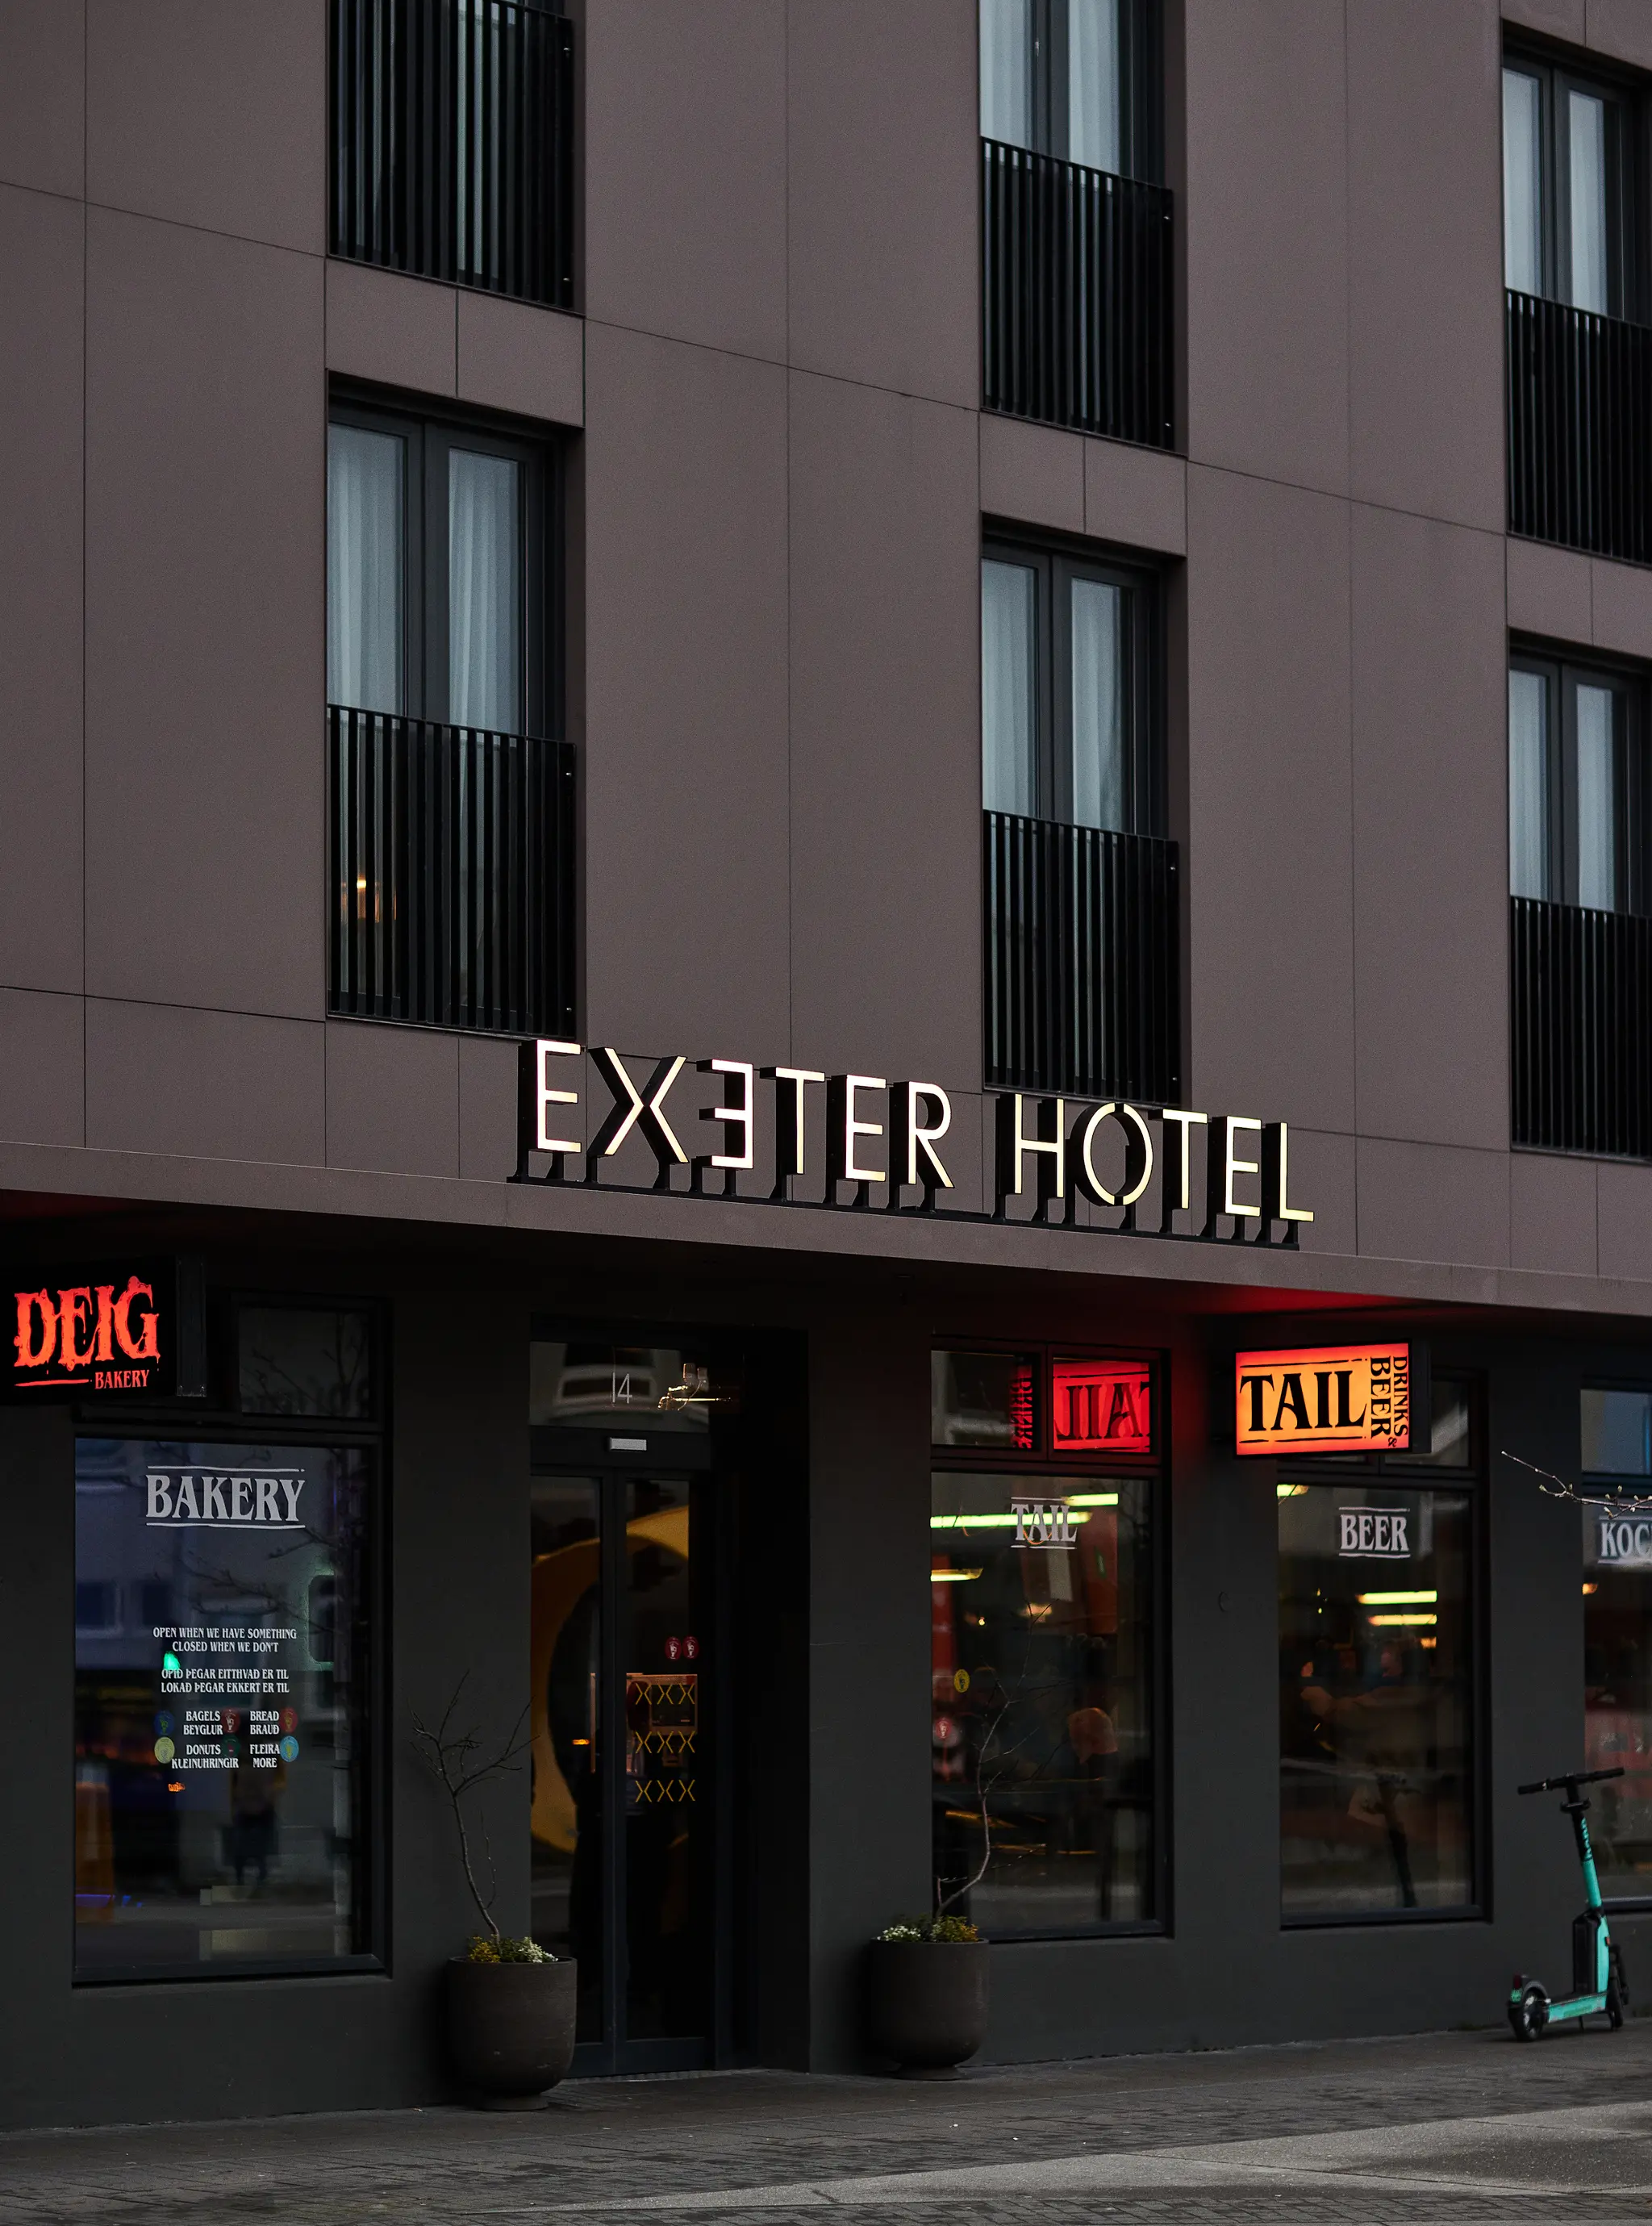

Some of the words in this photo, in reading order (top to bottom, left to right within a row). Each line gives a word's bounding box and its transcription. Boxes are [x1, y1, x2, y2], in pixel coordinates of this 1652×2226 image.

[1014, 1092, 1316, 1223] HOTEL
[13, 1275, 161, 1371] DEIG
[94, 1369, 151, 1389] BAKERY
[611, 1372, 633, 1404] 14
[1393, 1355, 1408, 1437] DRINKS
[1239, 1370, 1367, 1432] TAIL
[1370, 1355, 1391, 1439] BEER
[145, 1474, 306, 1522] BAKERY
[1010, 1503, 1078, 1543] TAIL
[1340, 1514, 1410, 1552] BEER
[1600, 1522, 1652, 1558] KOC
[152, 1627, 177, 1639] OPEN
[178, 1627, 205, 1639] WHEN
[206, 1627, 220, 1639] WE
[222, 1627, 245, 1639] HAVE
[247, 1627, 298, 1639] SOMETHING
[172, 1640, 208, 1653] CLOSED
[210, 1640, 236, 1653] WHEN
[237, 1640, 251, 1653] WE
[252, 1640, 279, 1653] DON'T
[261, 1668, 274, 1680] ER
[275, 1668, 290, 1680] TIL
[226, 1681, 261, 1694] EKKERT
[262, 1681, 275, 1694] ER
[276, 1681, 290, 1694] TIL
[186, 1710, 221, 1722] BAGELS
[249, 1710, 280, 1722] BREAD
[183, 1723, 223, 1735] BEYGLUR
[186, 1744, 222, 1756] DONUTS
[249, 1743, 280, 1755] FLEIRA
[171, 1757, 240, 1769] KLEINUHRINGIR
[252, 1757, 277, 1769] MORE
